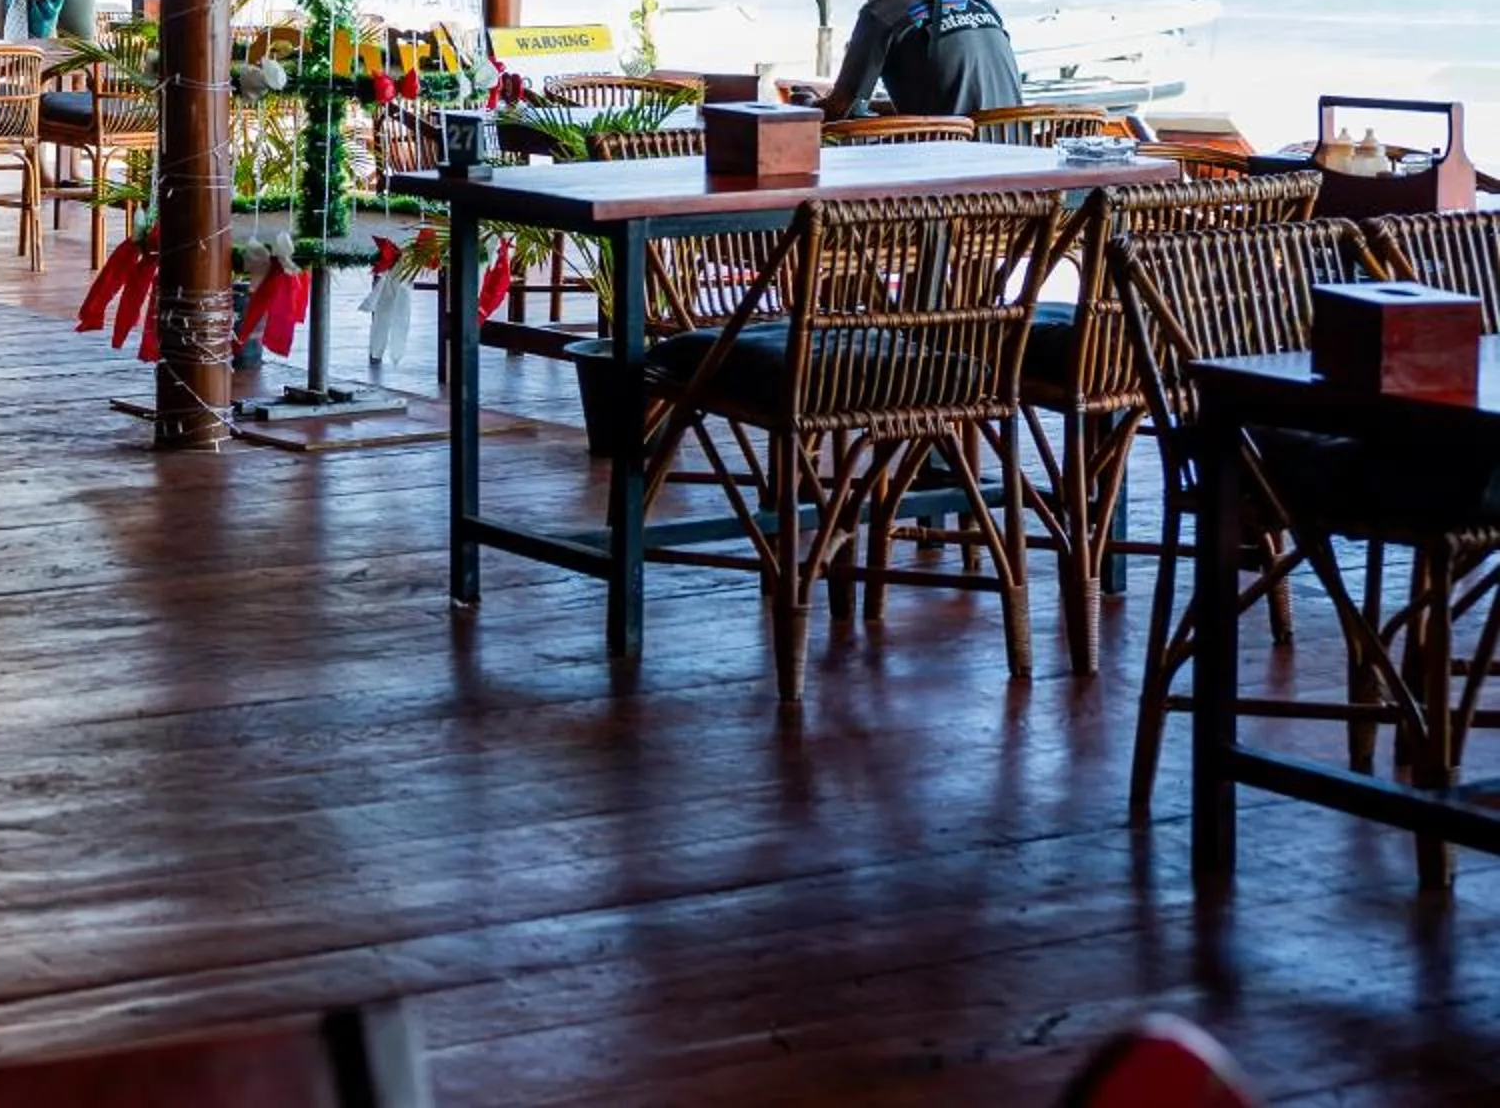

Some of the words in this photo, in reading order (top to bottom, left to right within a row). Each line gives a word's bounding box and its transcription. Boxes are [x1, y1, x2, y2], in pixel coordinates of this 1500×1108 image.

[940, 11, 1001, 31] atagon
[515, 33, 589, 50] WARNING
[448, 123, 476, 151] 27
